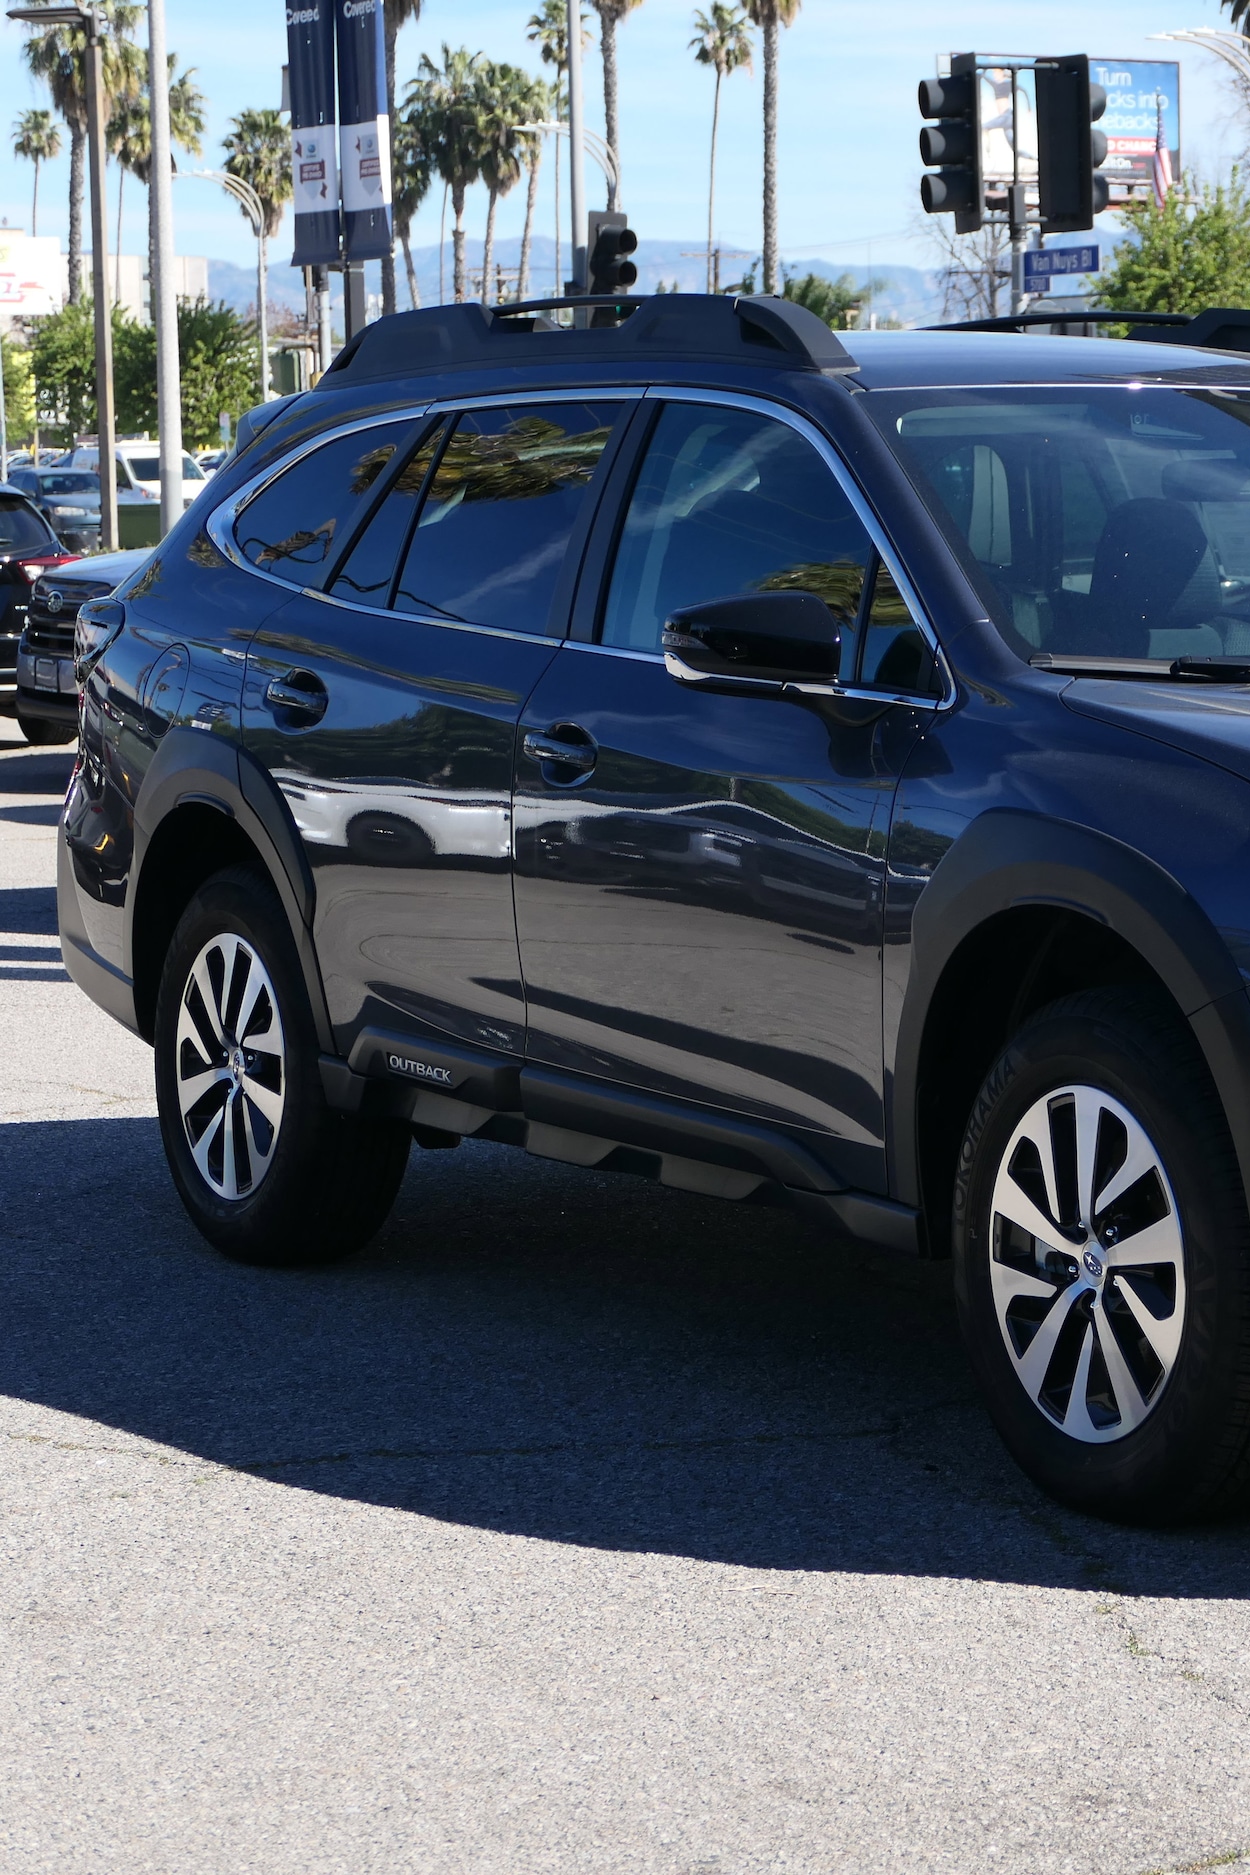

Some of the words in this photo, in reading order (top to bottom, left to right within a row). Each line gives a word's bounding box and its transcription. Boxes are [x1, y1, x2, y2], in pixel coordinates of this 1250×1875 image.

[1095, 67, 1132, 86] Turn
[1138, 90, 1169, 109] into
[1117, 141, 1157, 152] CHANC
[1031, 254, 1050, 272] Van
[1053, 251, 1078, 272] Nuys
[1081, 249, 1093, 268] Bl
[389, 1055, 452, 1084] OUTBACK
